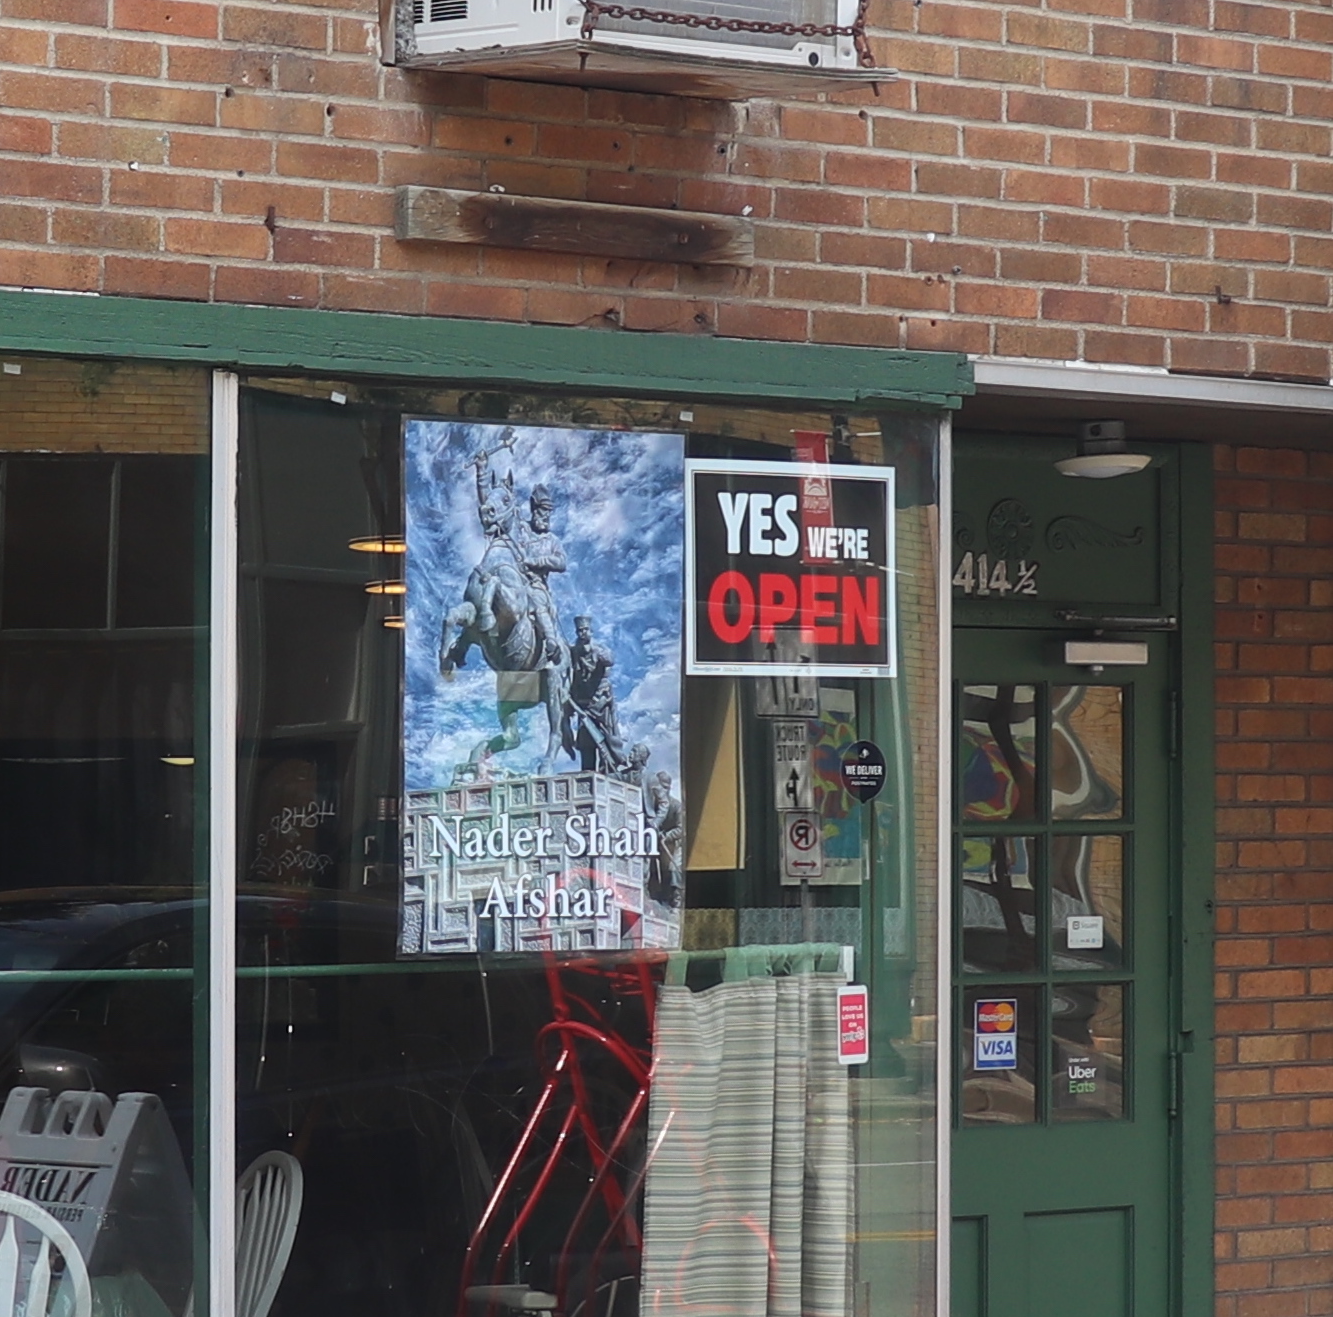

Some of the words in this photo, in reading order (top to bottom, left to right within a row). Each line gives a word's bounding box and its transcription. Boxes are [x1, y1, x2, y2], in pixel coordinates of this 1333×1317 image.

[717, 492, 800, 557] YES
[806, 526, 870, 560] WE'RE
[707, 569, 880, 646] OPEN
[844, 764, 857, 776] WE
[856, 764, 883, 776] DELIVER
[428, 812, 553, 858] Nader
[564, 812, 661, 858] Shah
[479, 873, 615, 918] Afshar
[979, 1040, 1014, 1056] VISA
[1068, 1065, 1097, 1079] Uber
[1068, 1080, 1097, 1094] Eats
